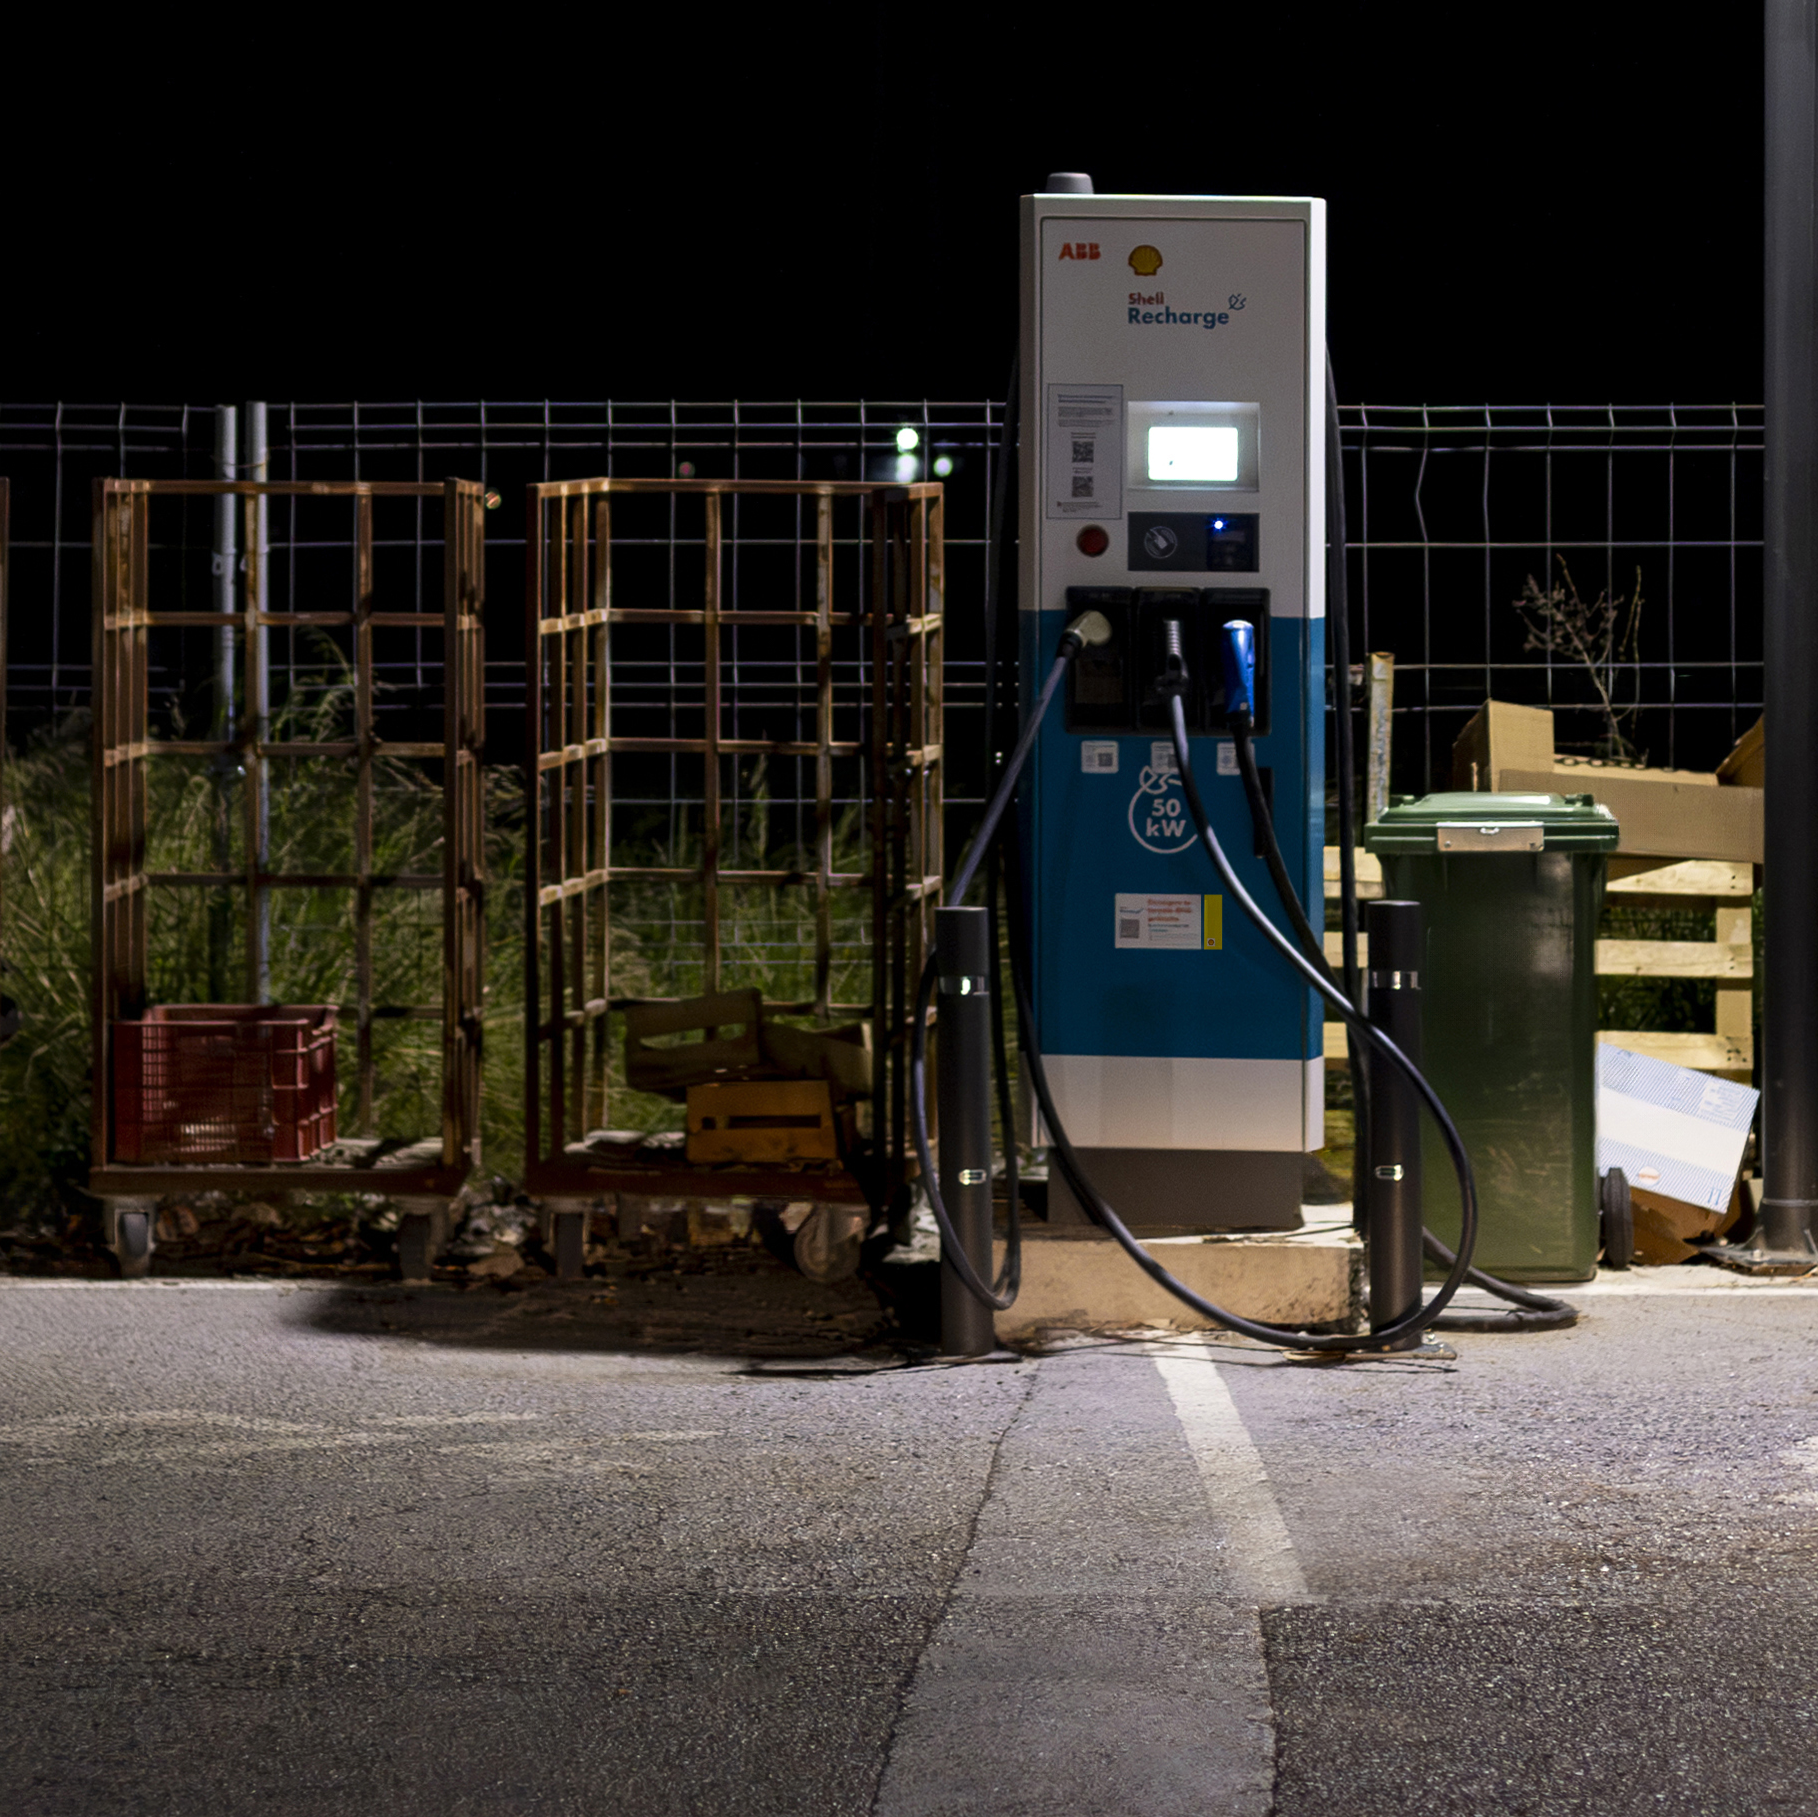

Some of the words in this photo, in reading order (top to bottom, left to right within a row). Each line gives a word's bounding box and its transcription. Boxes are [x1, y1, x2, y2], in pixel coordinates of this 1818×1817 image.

[1059, 243, 1101, 261] ABB
[1128, 291, 1165, 305] Shell
[1128, 306, 1230, 330] Recharge
[1151, 798, 1181, 818] 50
[1146, 817, 1186, 837] kW
